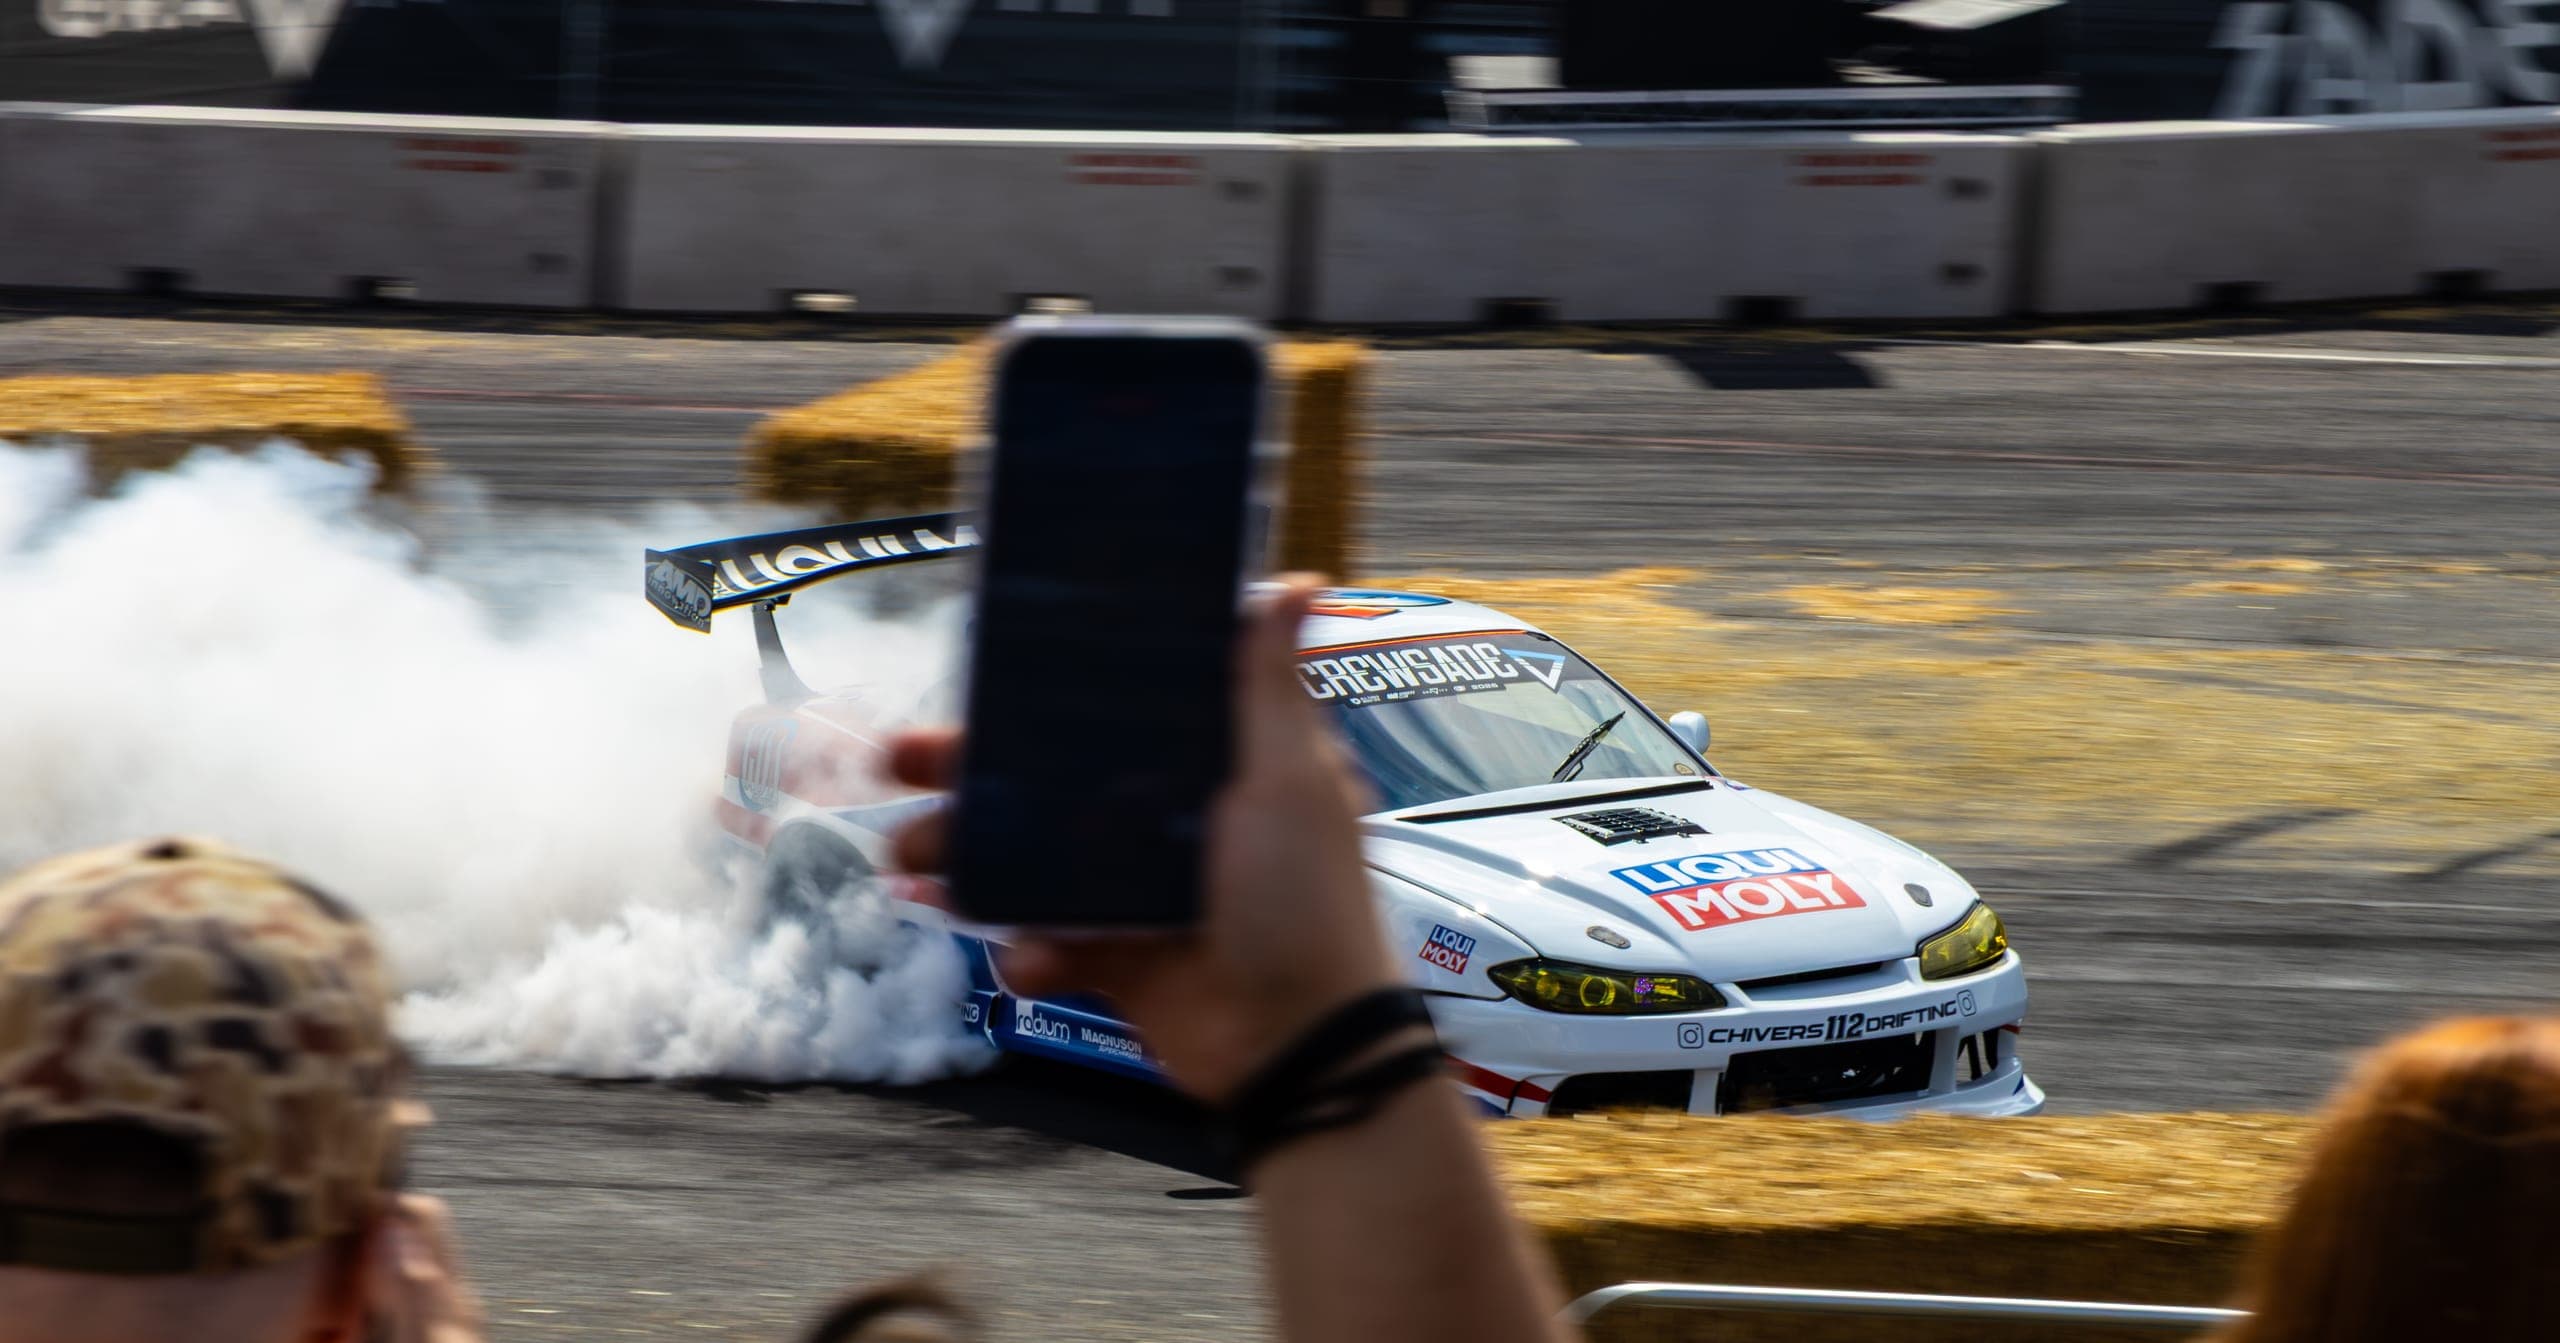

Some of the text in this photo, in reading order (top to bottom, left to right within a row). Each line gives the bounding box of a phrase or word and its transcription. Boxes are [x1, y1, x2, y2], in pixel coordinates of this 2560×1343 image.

[1292, 642, 1519, 699] CREWSADE
[1621, 850, 1816, 893] LIQUI
[1662, 873, 1848, 927] MOLY
[1431, 926, 1474, 955] LIQUI
[1421, 943, 1467, 972] MOLY
[1017, 1012, 1070, 1041] radium
[1081, 1027, 1142, 1053] MAGNUSON
